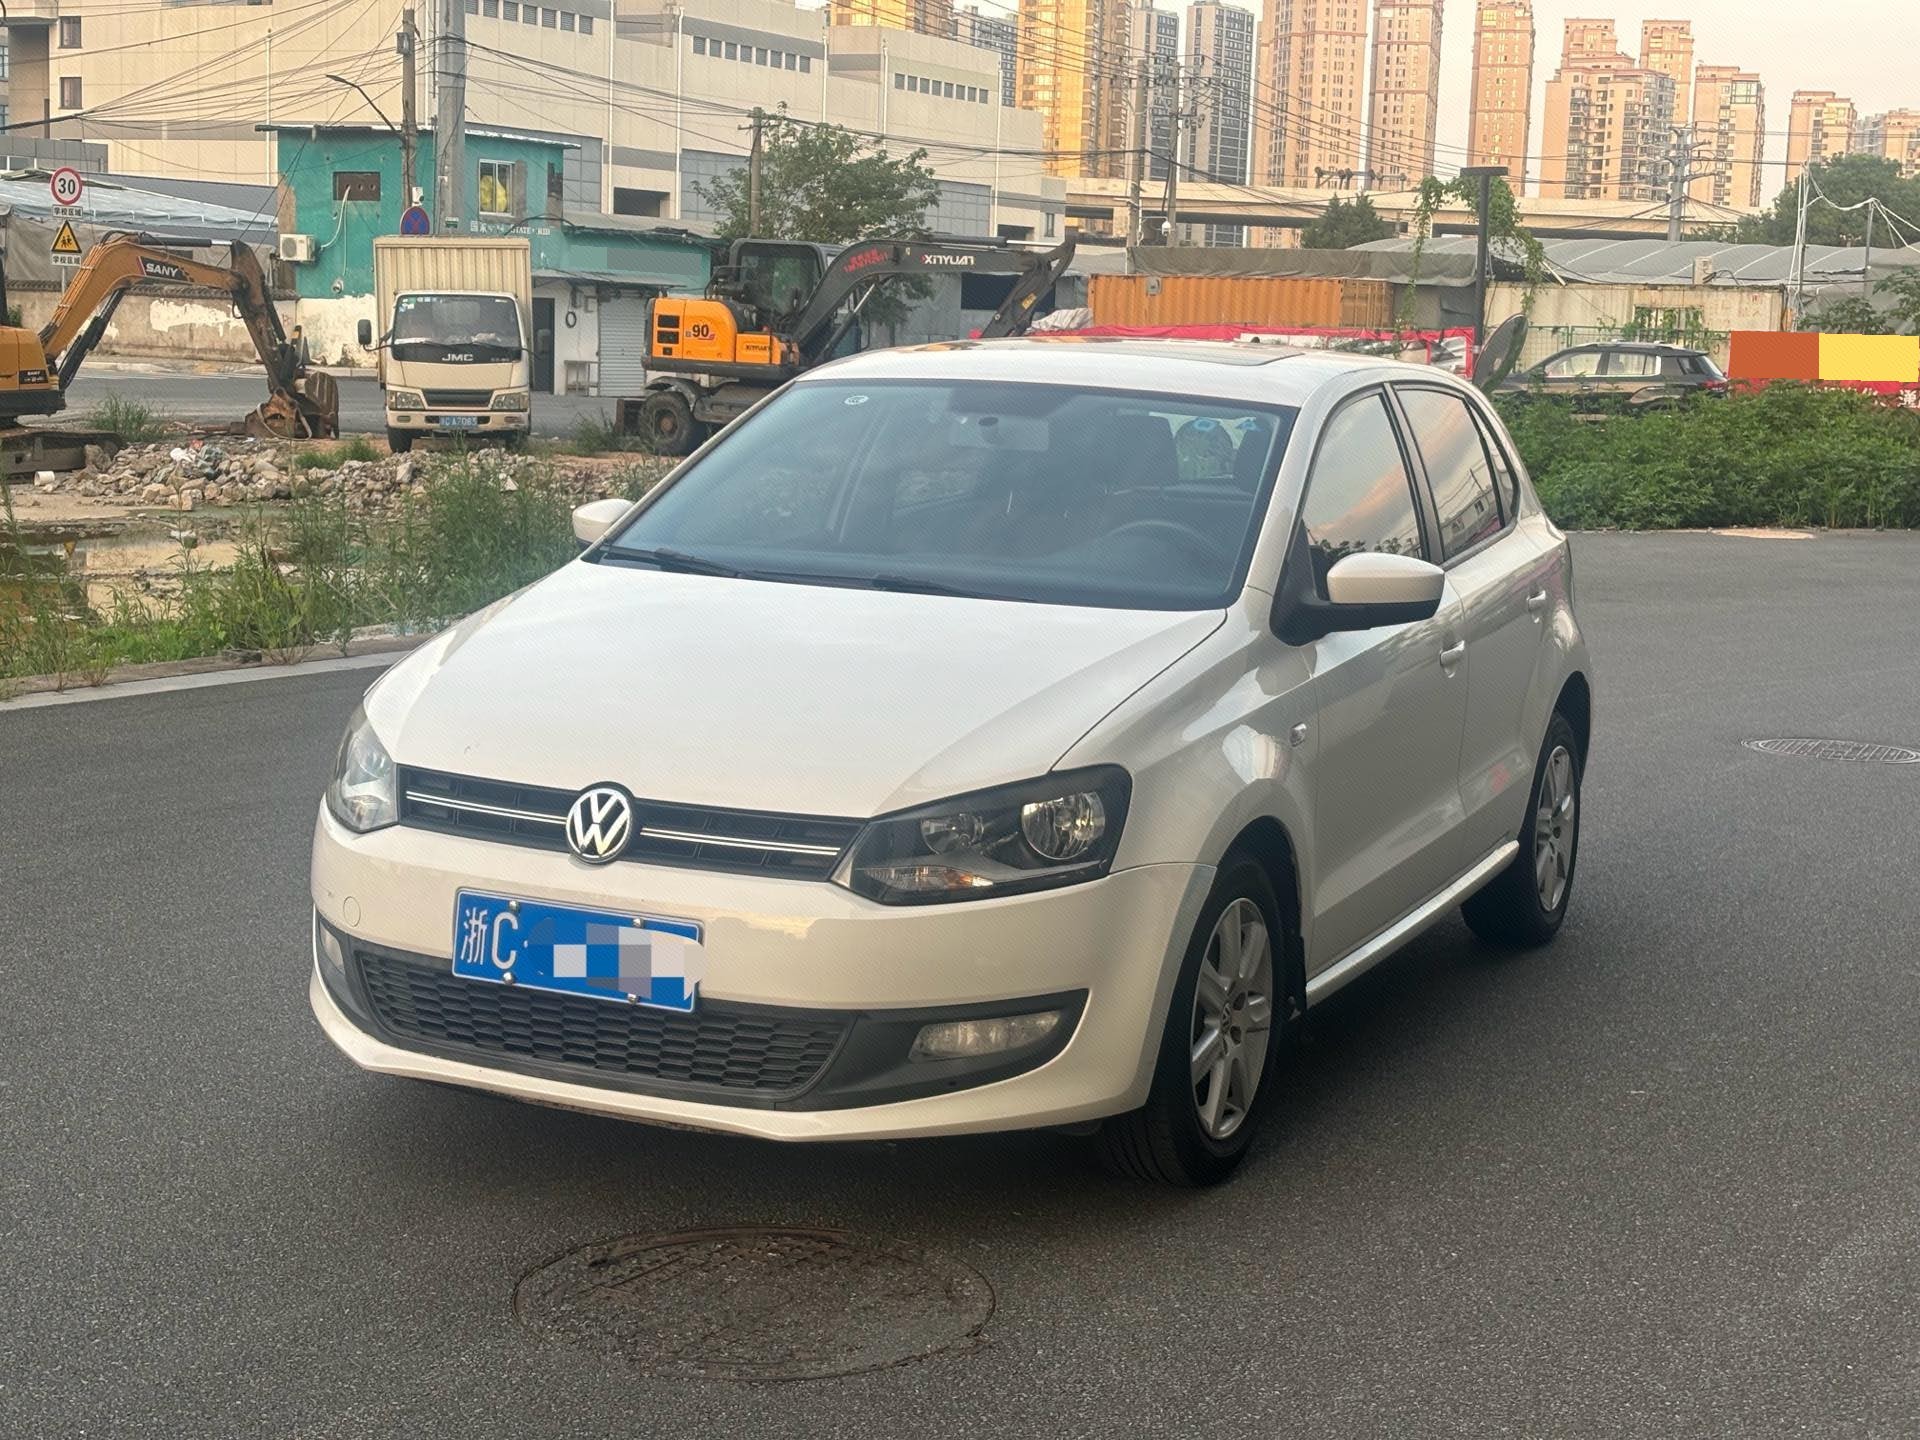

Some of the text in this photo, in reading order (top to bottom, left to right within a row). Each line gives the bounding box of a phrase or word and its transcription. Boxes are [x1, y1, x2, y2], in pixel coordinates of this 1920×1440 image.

[58, 178, 76, 195] 30
[54, 207, 82, 217] 学校区域
[53, 255, 81, 265] 学校区域
[146, 262, 178, 278] SANY
[692, 324, 709, 338] 90
[441, 353, 474, 362] JMC
